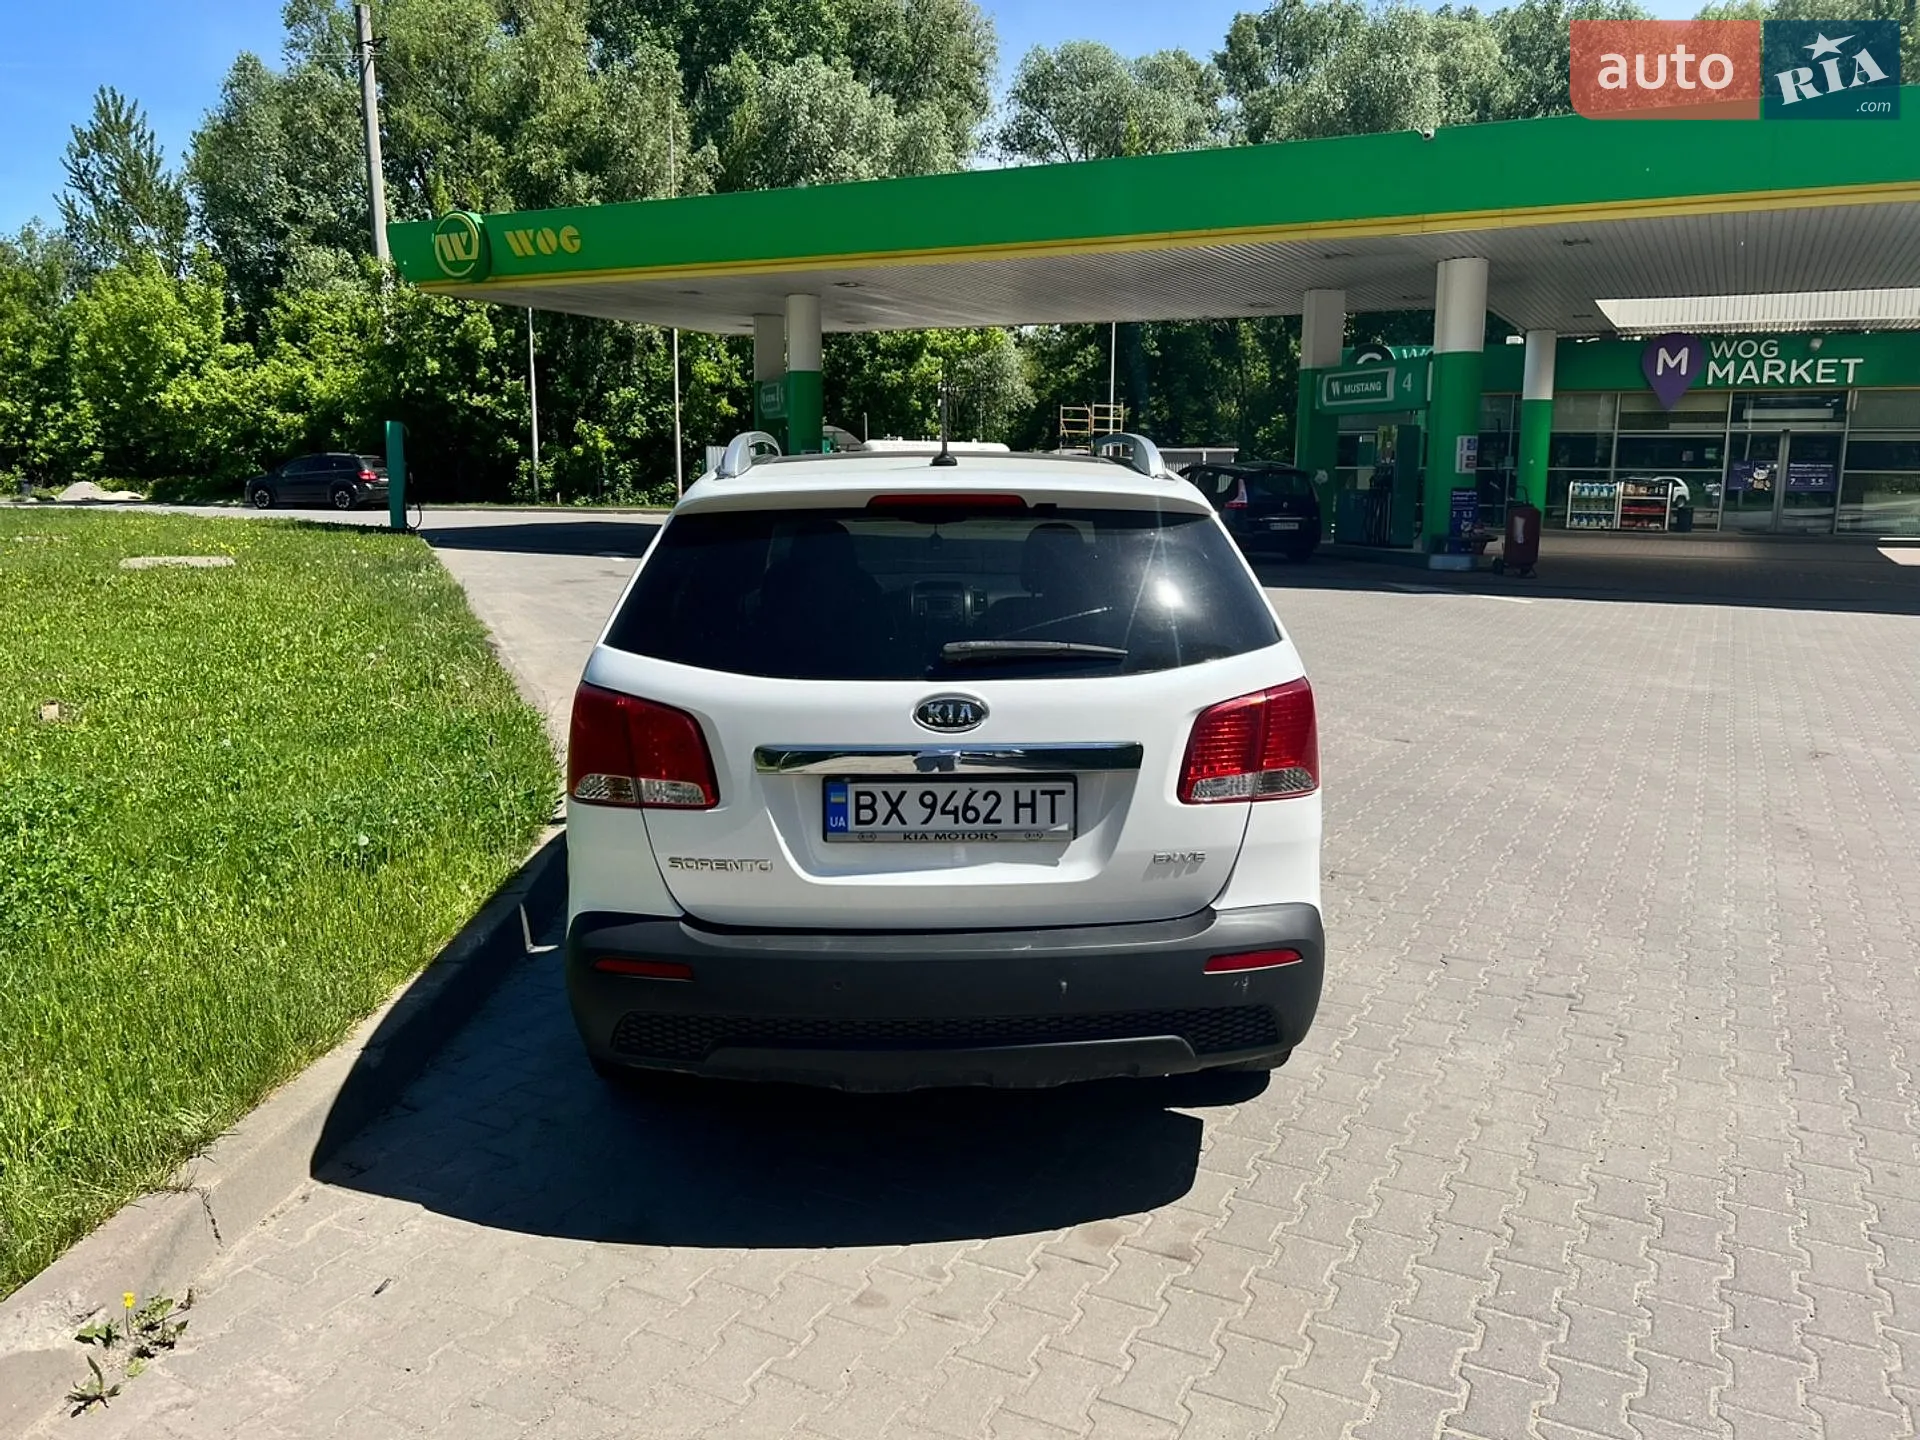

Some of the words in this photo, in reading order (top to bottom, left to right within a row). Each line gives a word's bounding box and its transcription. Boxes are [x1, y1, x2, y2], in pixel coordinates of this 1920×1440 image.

[504, 225, 581, 257] WOG
[1710, 339, 1779, 359] WOG
[1656, 347, 1689, 376] M
[1707, 358, 1864, 385] MARKET
[1344, 381, 1382, 394] MUSTANG
[1402, 373, 1412, 391] 4
[927, 703, 975, 723] KIA
[854, 790, 907, 825] BX
[919, 788, 1002, 825] 9462
[1014, 790, 1066, 825] HT
[830, 816, 846, 827] UA
[903, 832, 928, 841] KIA
[934, 832, 998, 841] MOTORS
[667, 857, 774, 872] SORENTO
